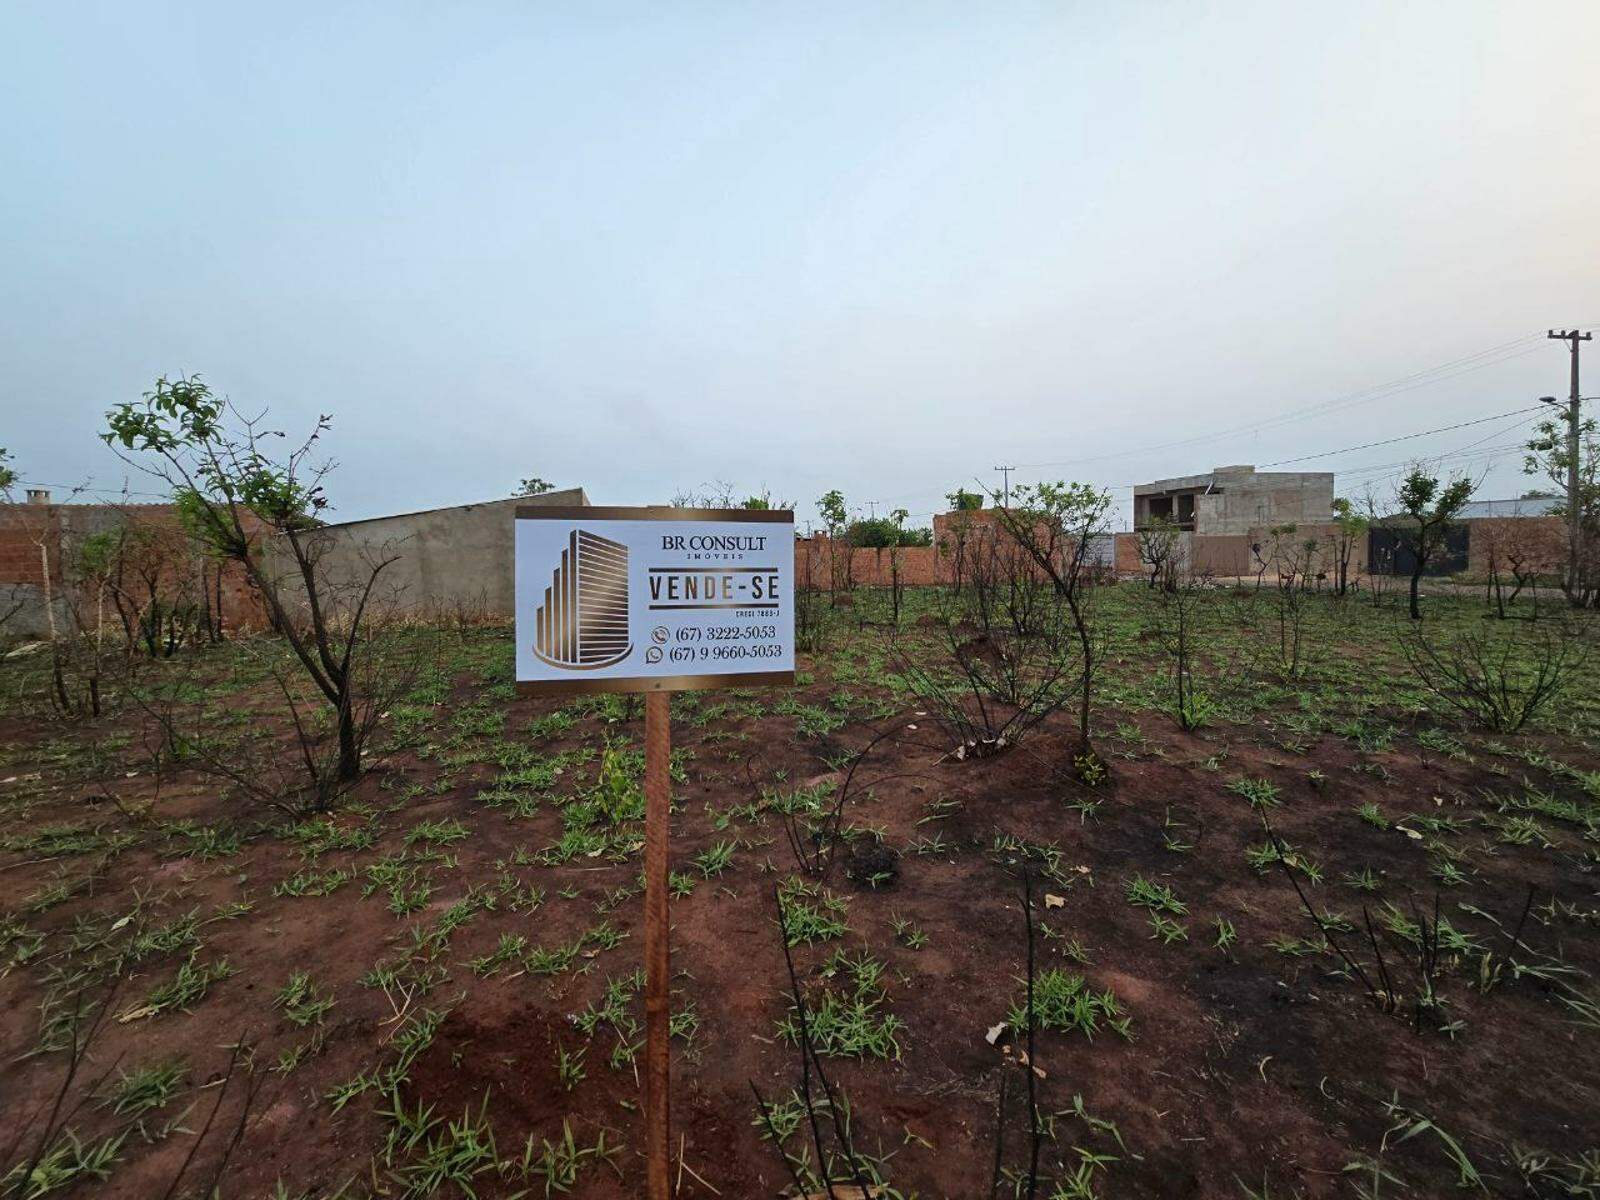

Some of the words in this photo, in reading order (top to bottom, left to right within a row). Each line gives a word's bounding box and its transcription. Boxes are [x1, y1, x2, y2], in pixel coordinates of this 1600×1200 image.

[662, 535, 687, 550] BR
[689, 535, 767, 551] CONSULT
[649, 575, 780, 600] VENDE-SE
[675, 626, 702, 643] (67)
[707, 625, 776, 641] 3222-5053
[669, 646, 696, 663] (67)
[700, 647, 709, 661] 9
[713, 644, 782, 660] 9660-5053
